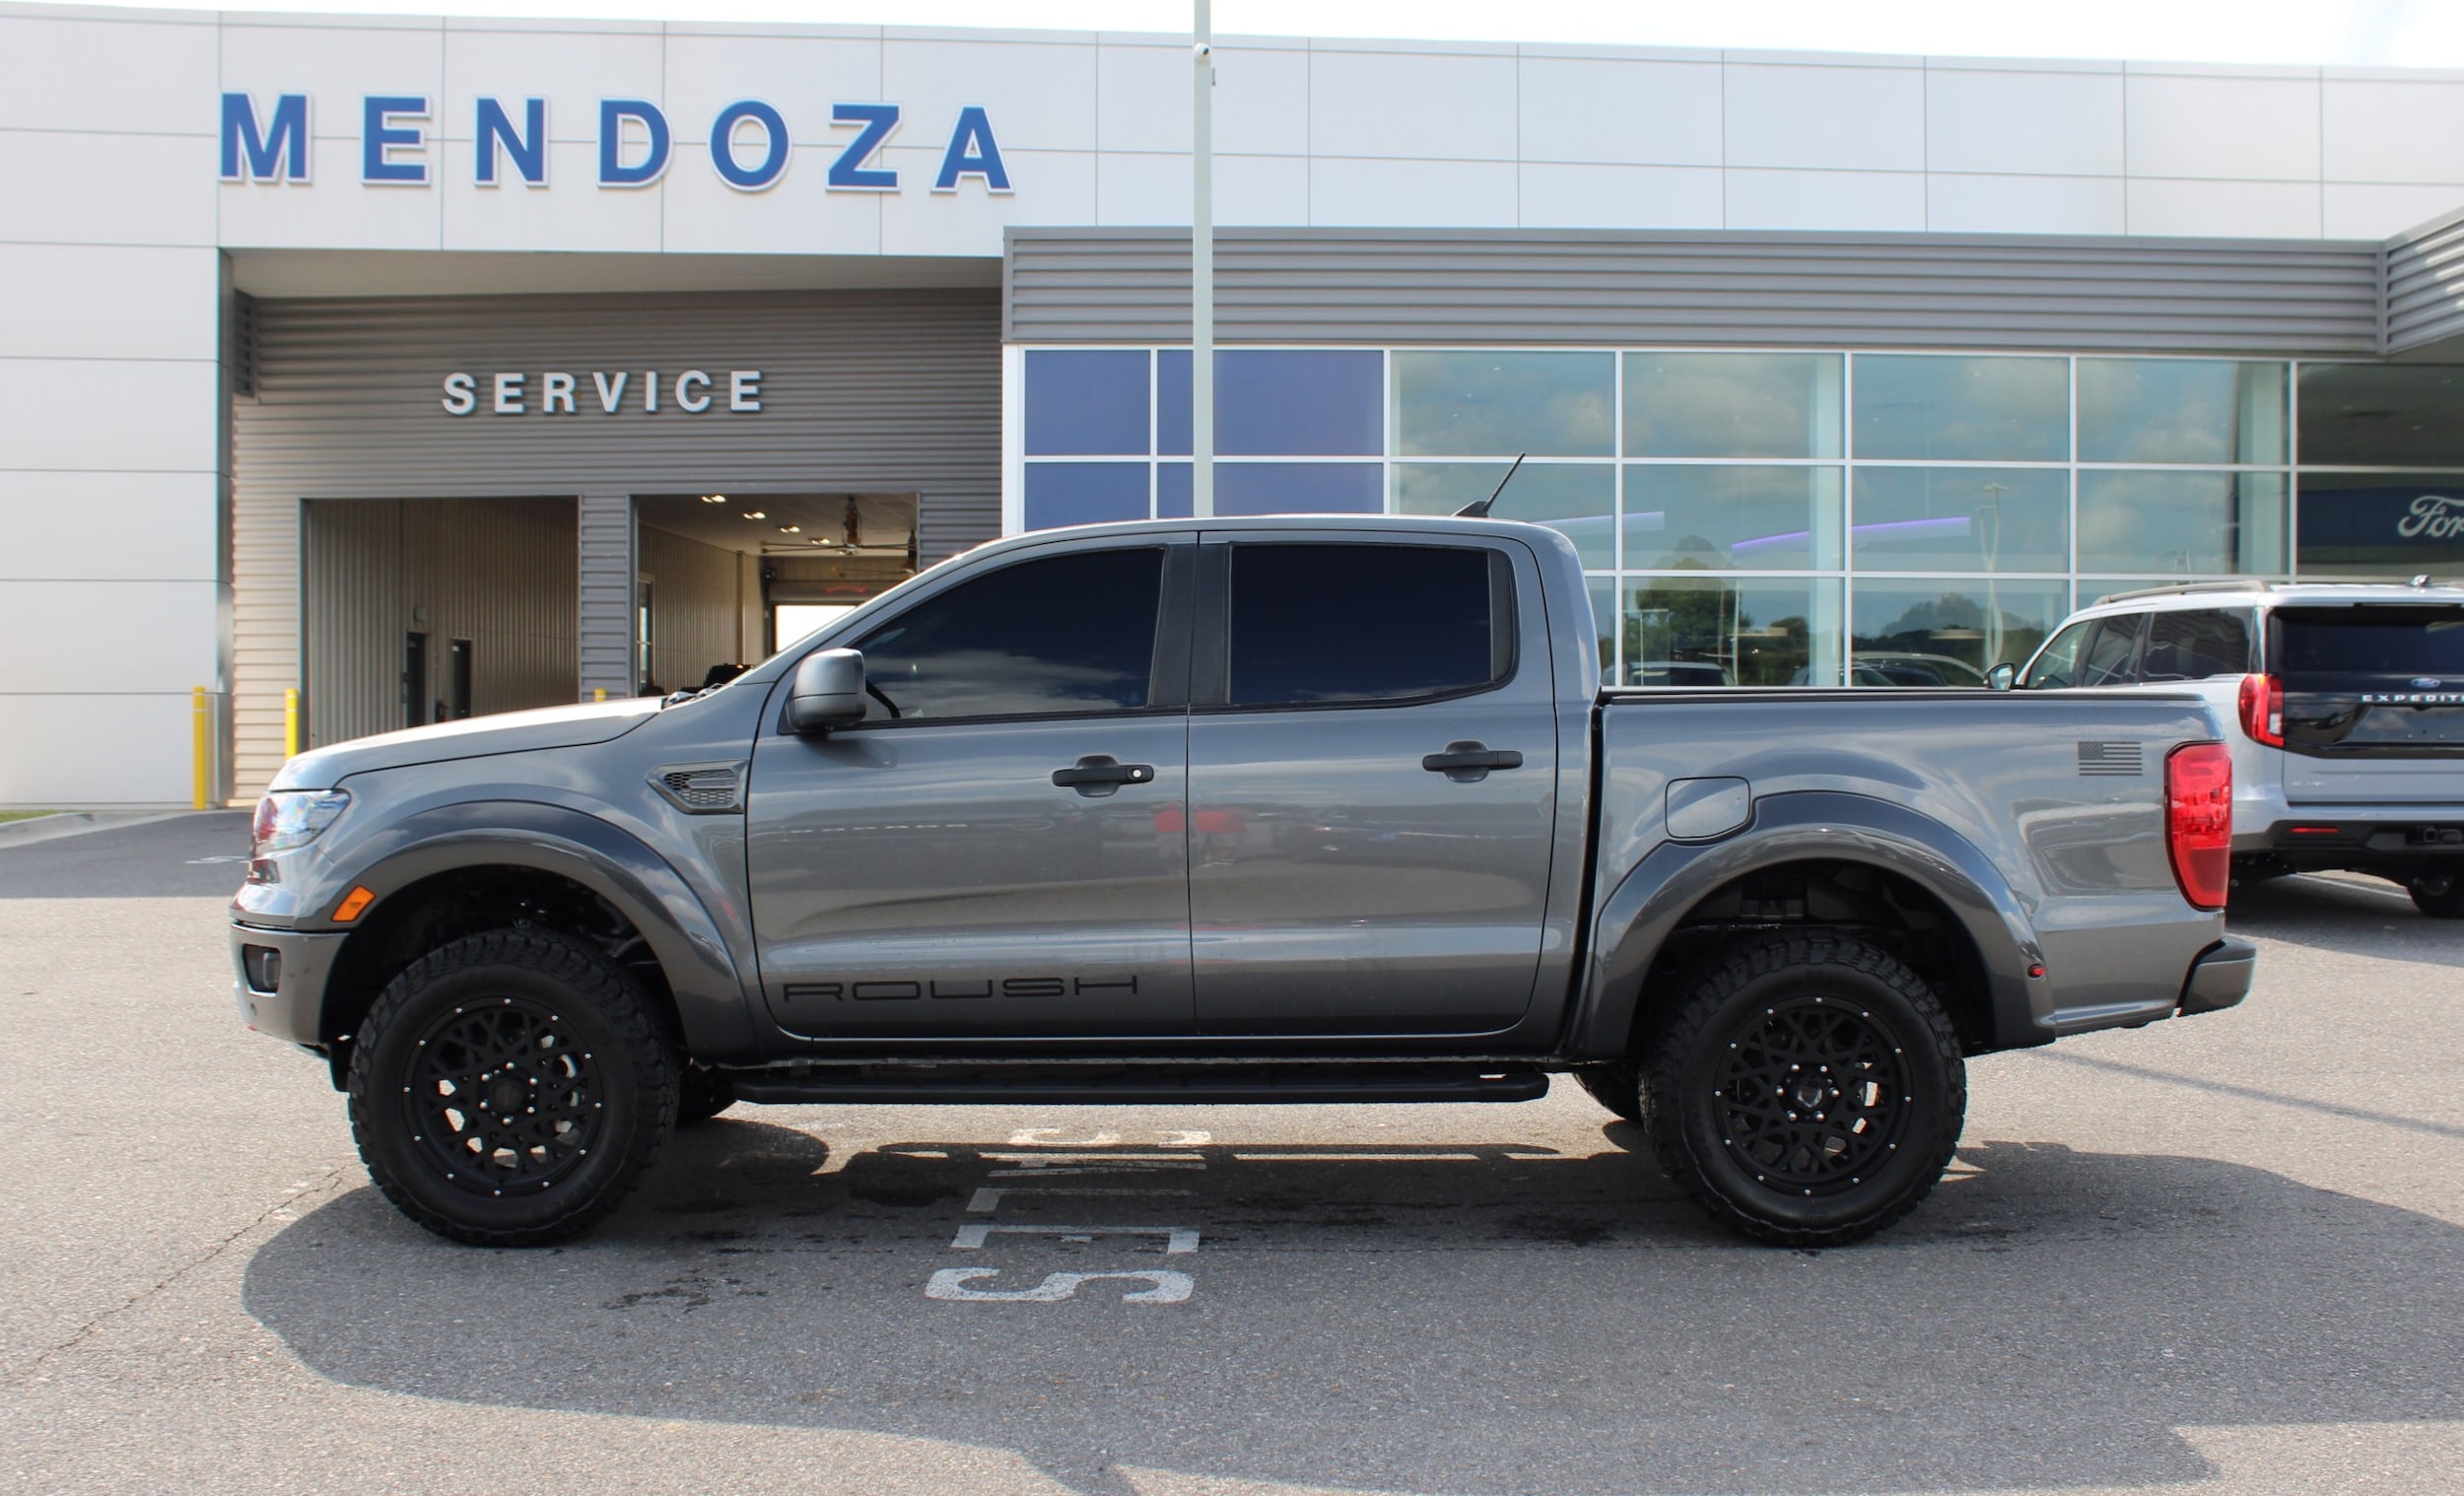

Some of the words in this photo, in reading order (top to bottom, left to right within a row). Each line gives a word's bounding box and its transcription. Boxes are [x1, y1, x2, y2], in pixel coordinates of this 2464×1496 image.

[220, 92, 1014, 195] MENDOZA
[442, 369, 765, 416] SERVICE
[2398, 495, 2464, 538] For
[2361, 694, 2464, 703] EXPEDIT
[783, 975, 1137, 1002] ROUSH
